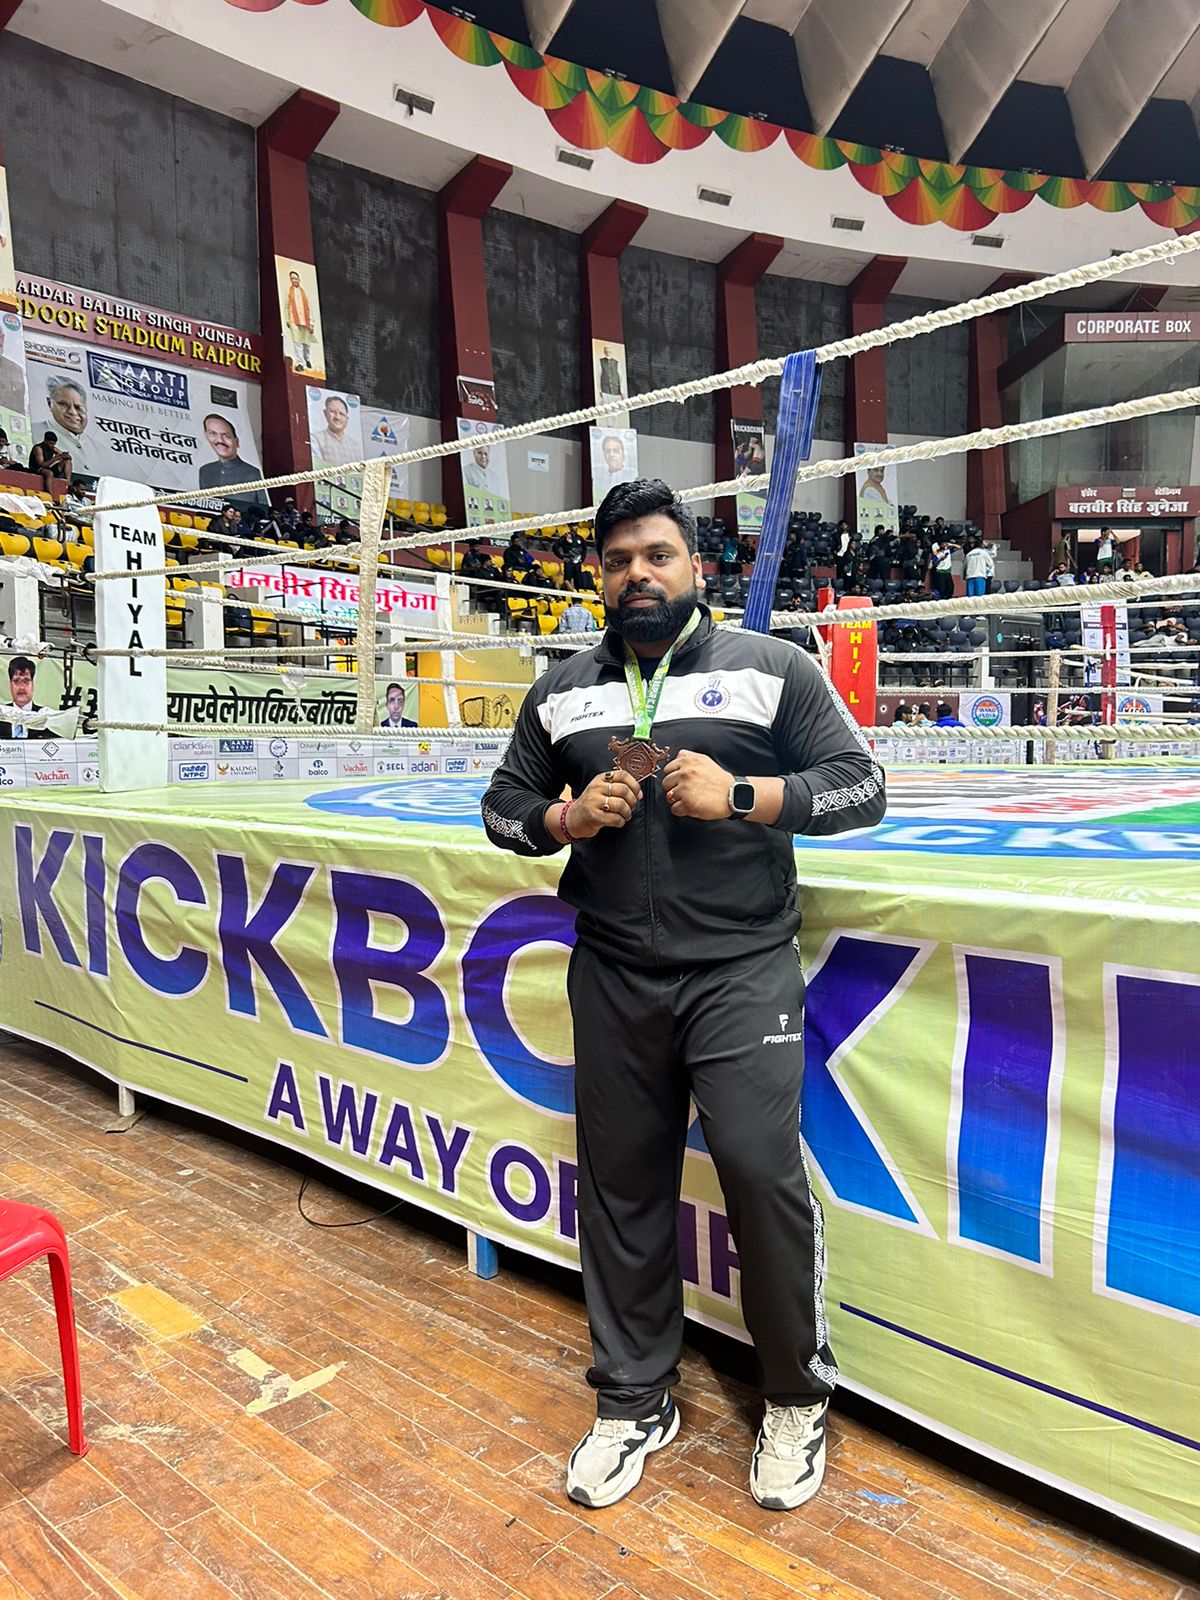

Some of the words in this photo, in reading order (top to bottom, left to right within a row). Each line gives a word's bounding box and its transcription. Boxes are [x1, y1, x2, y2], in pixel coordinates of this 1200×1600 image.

[17, 279, 76, 305] ARDAR
[83, 295, 142, 322] BALBIR
[147, 312, 192, 335] SINGH
[197, 326, 252, 350] JUNEJA
[1076, 319, 1160, 334] CORPORATE
[1165, 319, 1191, 333] BOX
[16, 297, 87, 332] DOOR
[95, 316, 187, 355] STADIUM
[191, 340, 262, 374] RAIPUR
[125, 363, 186, 389] AARTI
[123, 378, 185, 400] GROUP
[92, 393, 134, 409] MAKING
[136, 403, 156, 414] LIFE
[158, 406, 192, 421] BETTER
[95, 416, 198, 449] स्वागत-वंदन
[111, 437, 193, 465] अभिनंदन
[1116, 499, 1144, 513] सिंह
[1146, 498, 1190, 516] जुनेजा
[110, 523, 157, 547] TEAM
[125, 550, 145, 677] HIYAL
[570, 711, 605, 723] FIGHTEX
[34, 770, 70, 781] Vachan
[343, 763, 368, 772] Vachan
[411, 761, 438, 772] adani
[267, 1063, 305, 1131] A
[319, 1076, 470, 1193] WAY
